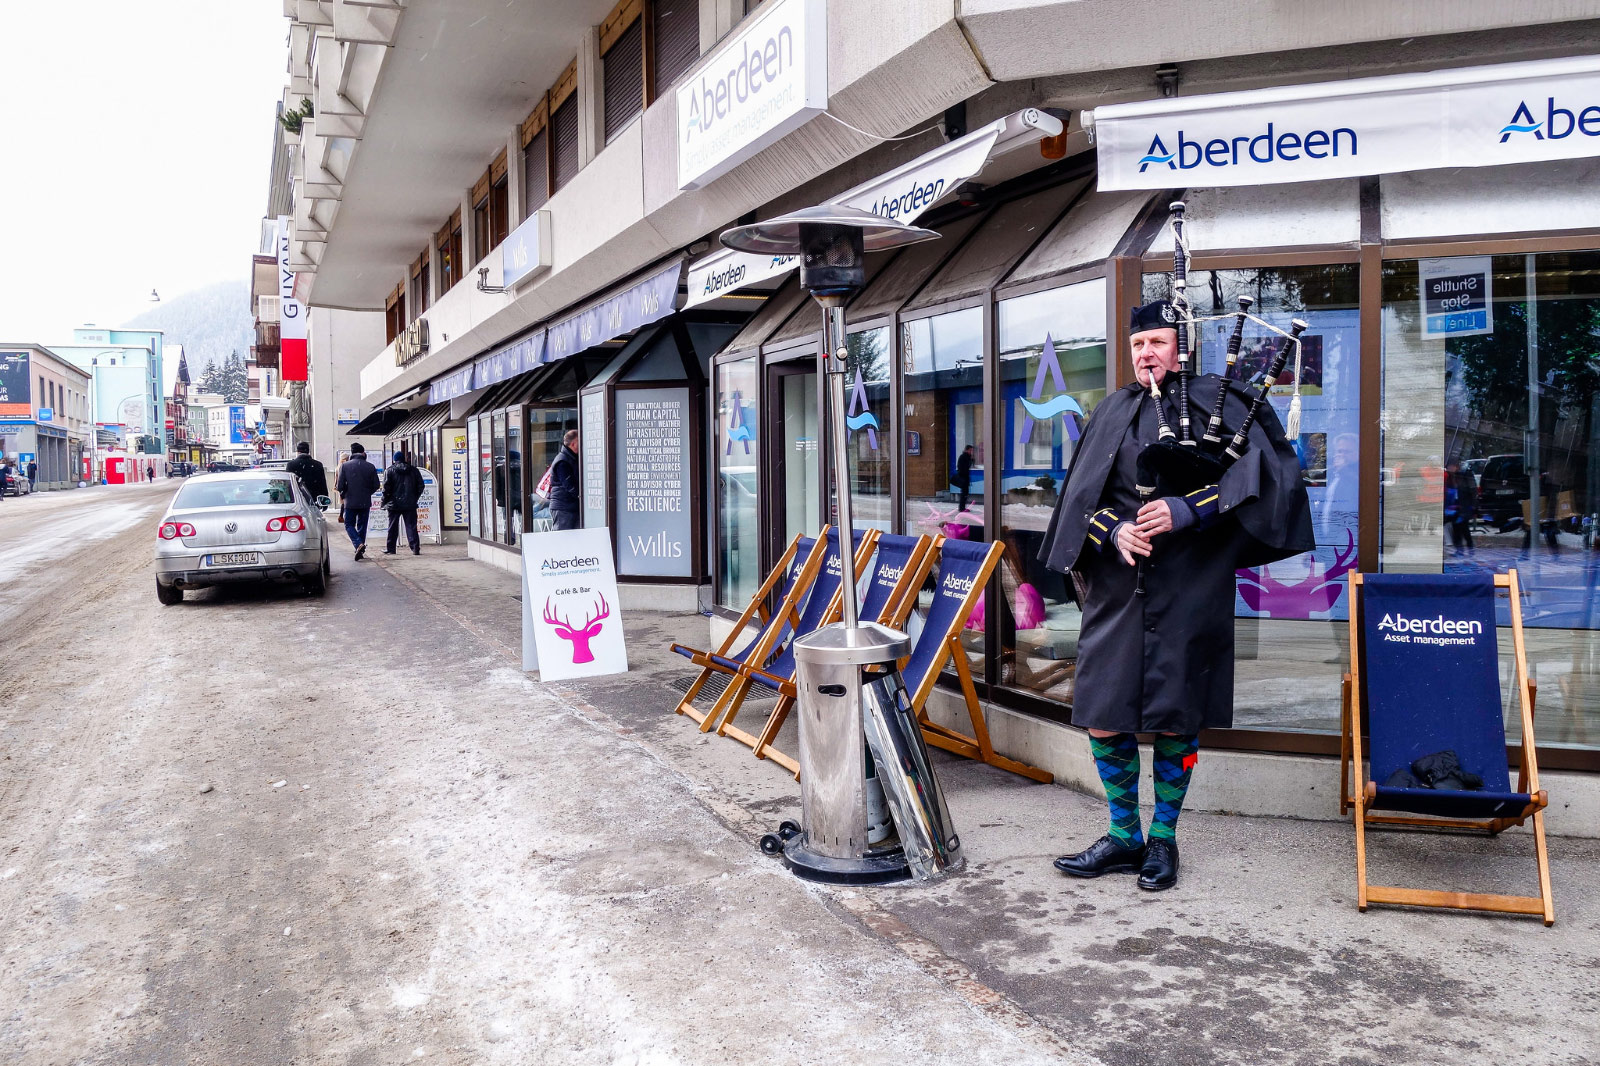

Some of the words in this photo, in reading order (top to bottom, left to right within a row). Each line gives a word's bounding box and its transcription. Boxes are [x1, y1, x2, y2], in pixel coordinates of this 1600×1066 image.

[686, 25, 793, 143] Aberdeen
[1138, 122, 1357, 173] Aberdeen
[703, 264, 746, 296] Aberdeen
[626, 410, 651, 420] HUMAN
[652, 409, 680, 419] CAPITAL
[626, 428, 680, 438] INFRASTRUCTURE
[663, 438, 680, 446] CYBER
[626, 463, 649, 471] NATURAL
[651, 463, 681, 471] RESOURCES
[627, 472, 649, 480] WEATHER
[663, 480, 681, 488] CYBER
[453, 460, 462, 523] MOLKEREI
[627, 497, 682, 512] RESILIENCE
[628, 530, 682, 558] Willis
[541, 555, 600, 570] Aberdeen
[580, 586, 592, 594] Bar
[1377, 613, 1482, 634] Aberdeen
[1384, 633, 1411, 643] Asset
[1413, 636, 1476, 647] management
